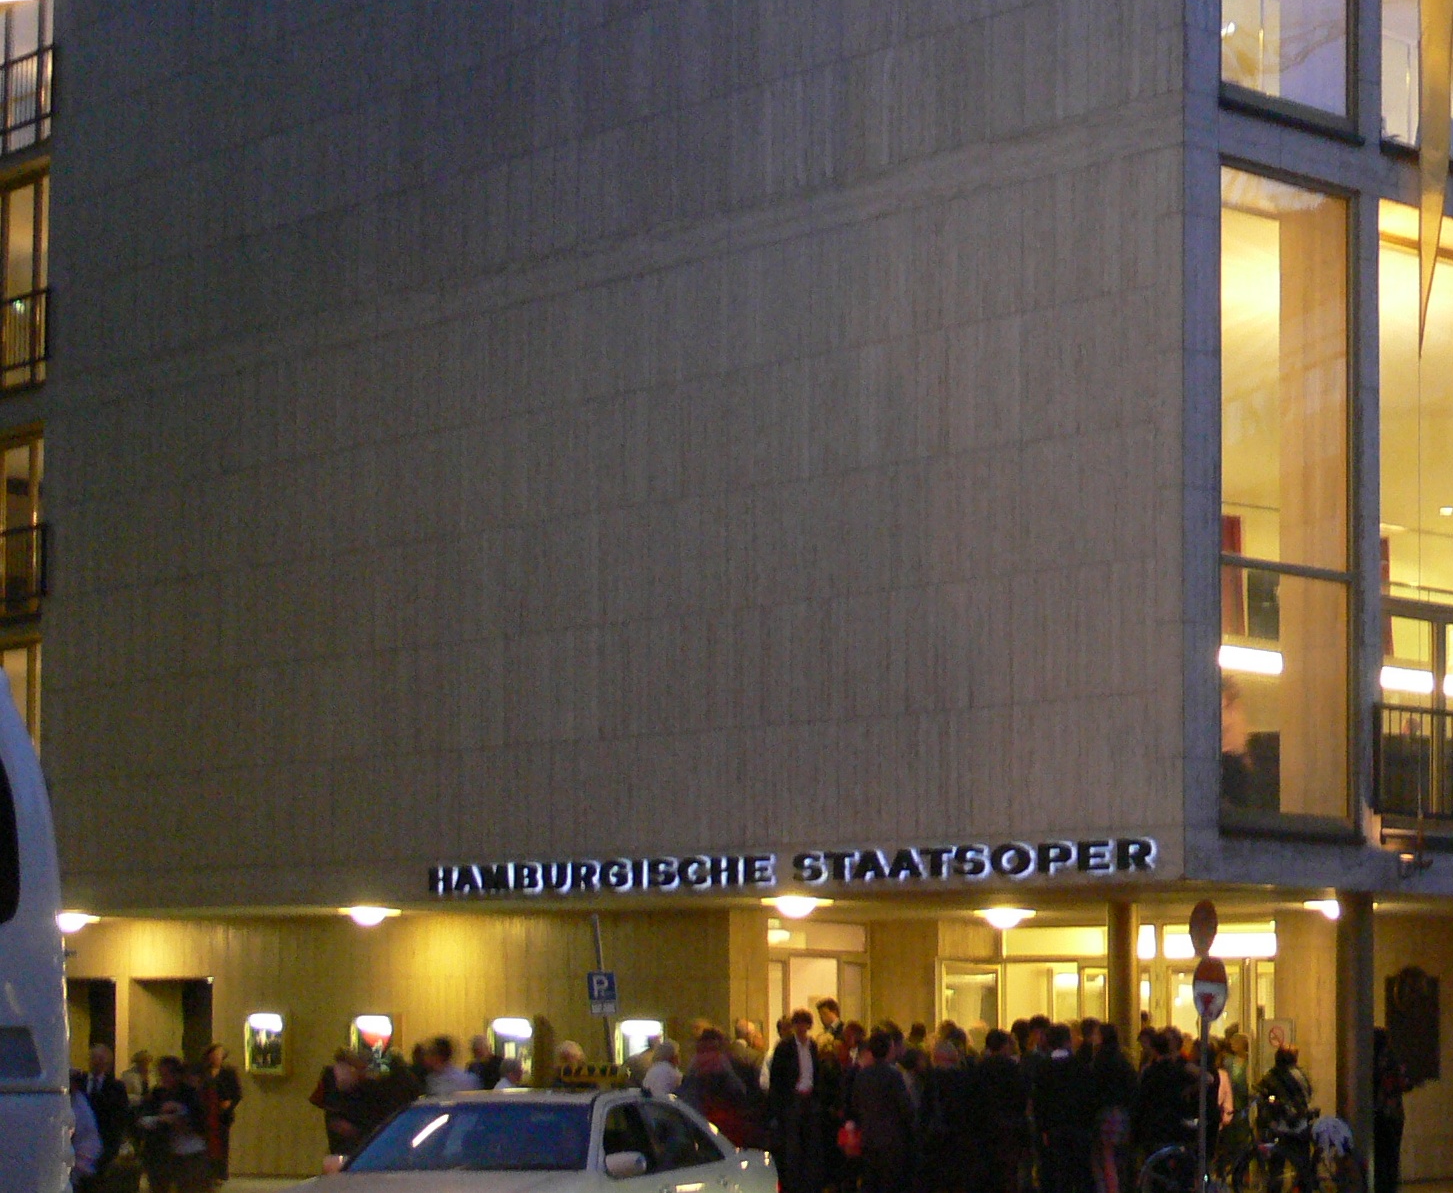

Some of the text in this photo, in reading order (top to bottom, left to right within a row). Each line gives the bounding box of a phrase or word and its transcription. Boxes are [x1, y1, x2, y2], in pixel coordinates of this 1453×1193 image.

[428, 836, 1158, 895] HAMBURGISCHE STAATSOPER
[592, 974, 609, 999] P
